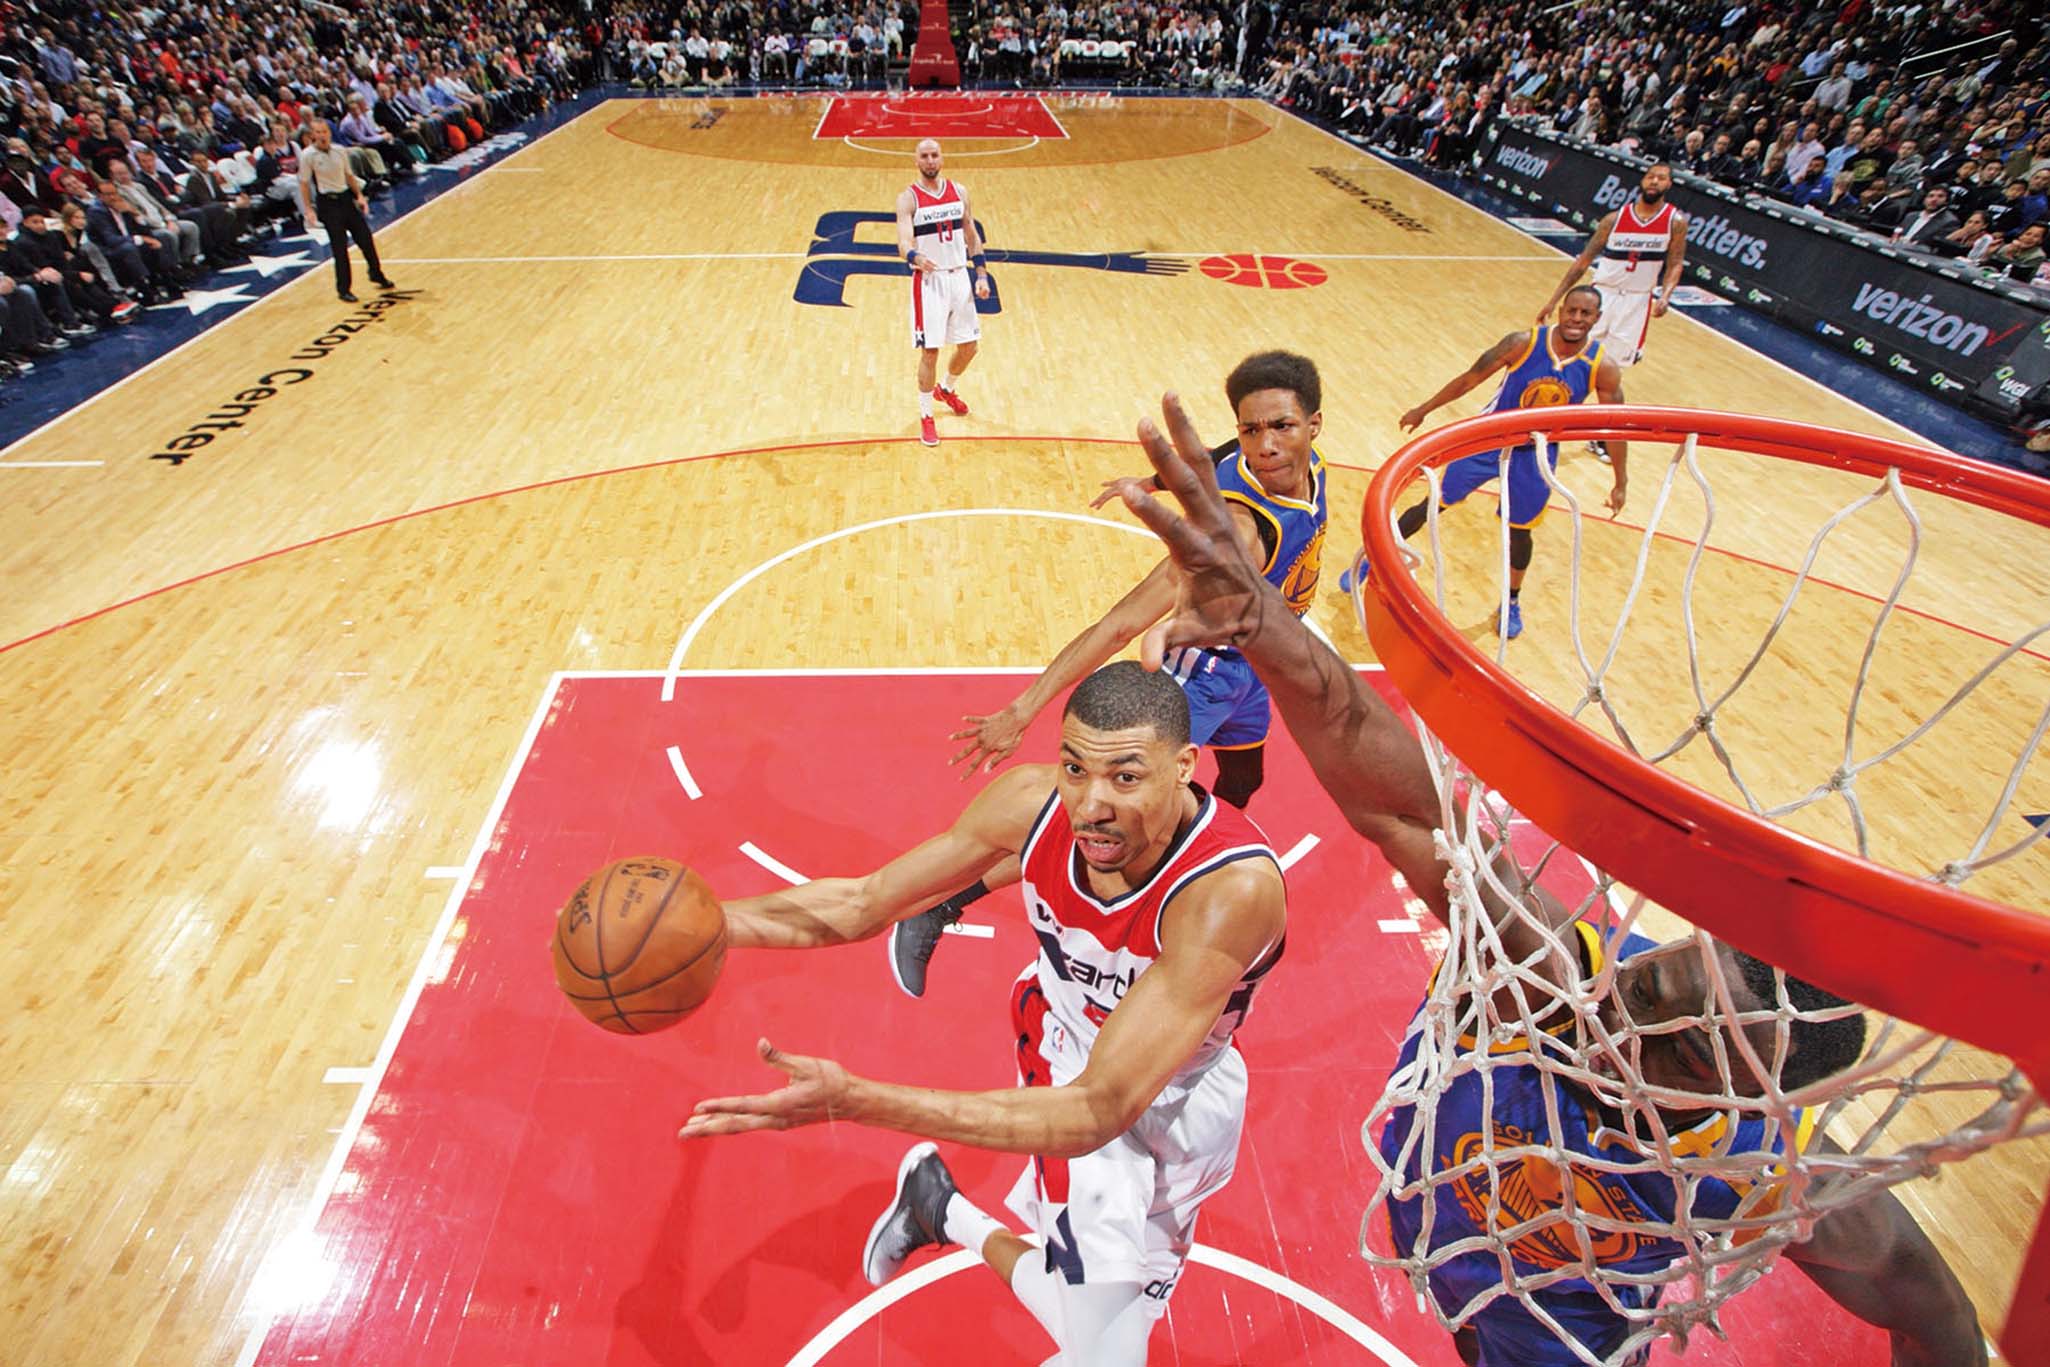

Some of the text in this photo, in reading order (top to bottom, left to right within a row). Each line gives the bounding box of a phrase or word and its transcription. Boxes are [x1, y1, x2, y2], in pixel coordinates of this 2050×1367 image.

[1496, 144, 1549, 179] verizon
[936, 219, 954, 244] 13
[1686, 211, 1768, 271] atters.
[1851, 282, 1990, 357] verizon
[148, 367, 315, 467] Center
